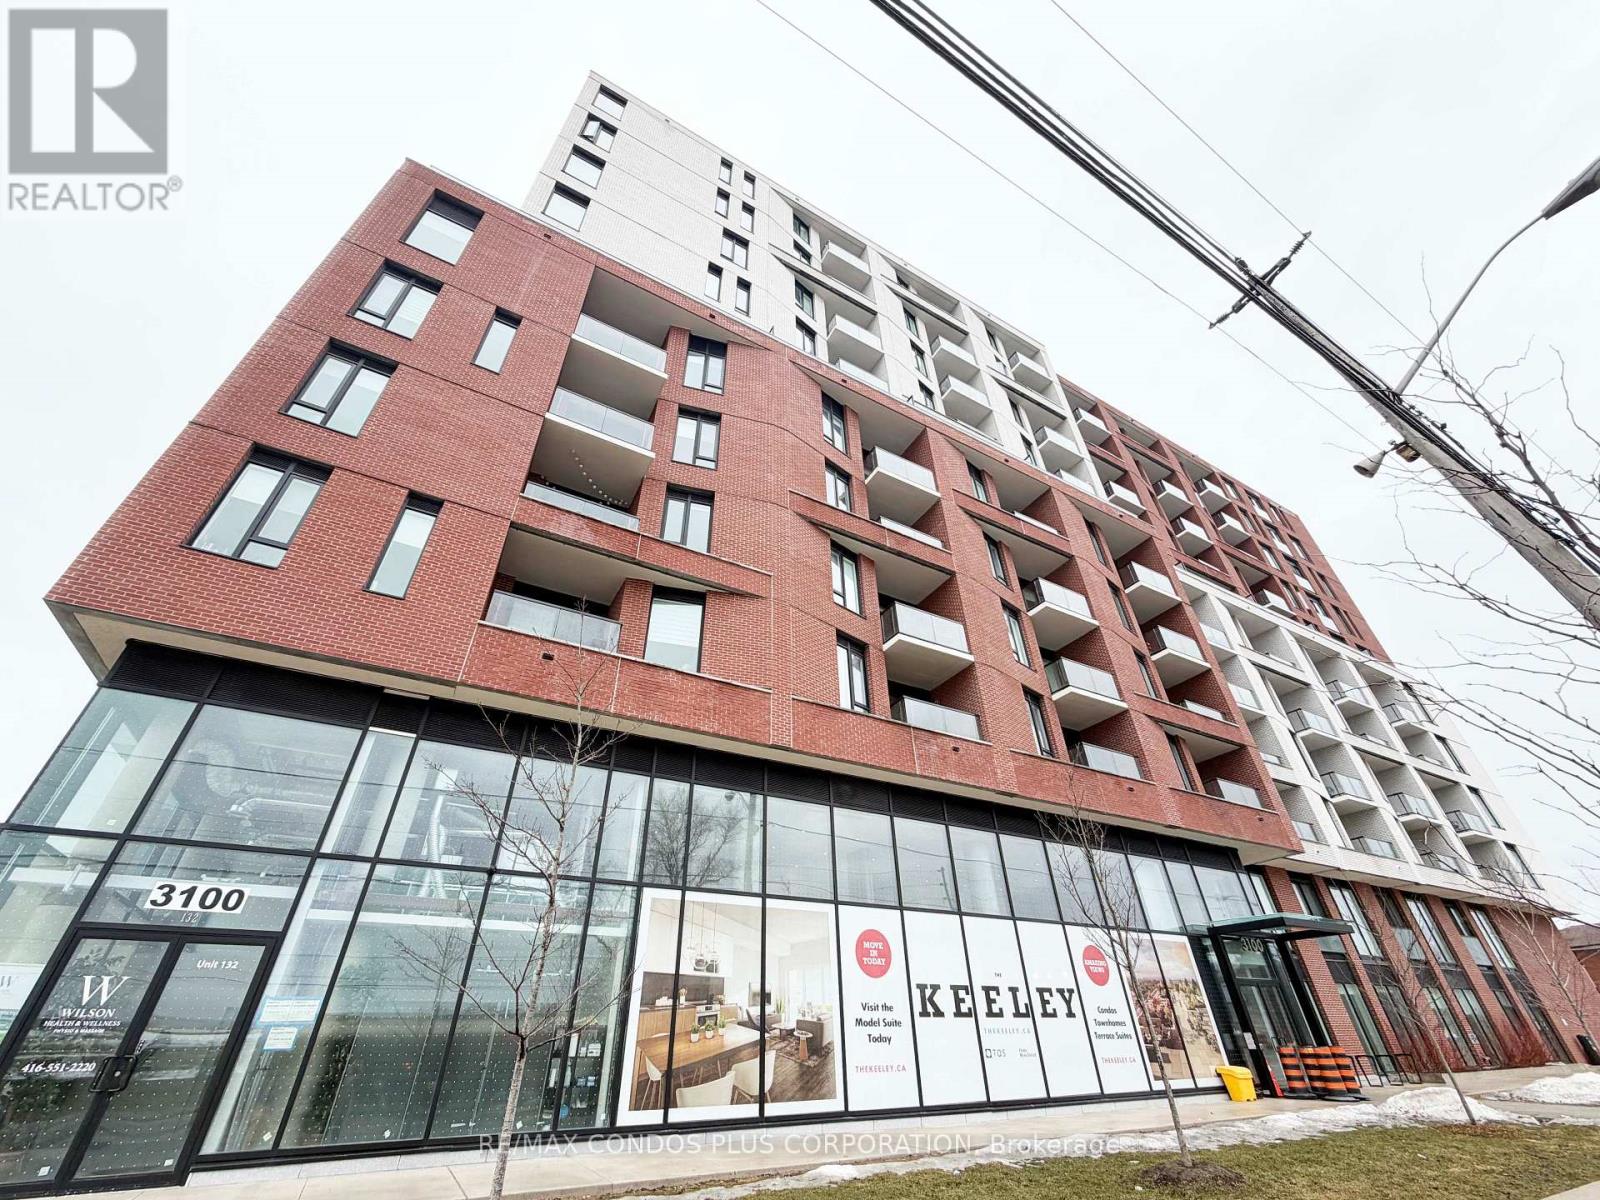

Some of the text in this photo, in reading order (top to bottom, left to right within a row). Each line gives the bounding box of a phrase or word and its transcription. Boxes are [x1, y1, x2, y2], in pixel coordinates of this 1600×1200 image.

[150, 884, 245, 911] 3100
[180, 912, 200, 923] 132
[863, 941, 884, 950] MOVE
[1241, 936, 1264, 952] 3100
[869, 949, 879, 957] IN
[196, 960, 239, 970] Unit 132
[862, 957, 886, 966] TODAY
[81, 975, 132, 1006] W
[916, 983, 1077, 1018] KEELEY
[861, 1002, 894, 1012] Visit the
[1097, 1006, 1117, 1014] Condos
[61, 1008, 116, 1018] WILSON
[855, 1018, 902, 1028] Model Suite
[1093, 1018, 1127, 1027] Townhomes
[867, 1034, 892, 1045] Today
[1094, 1031, 1132, 1040] Terrace Suites
[22, 1062, 96, 1073] 416-551-2220
[855, 1064, 906, 1073] THEKEELEY.CA
